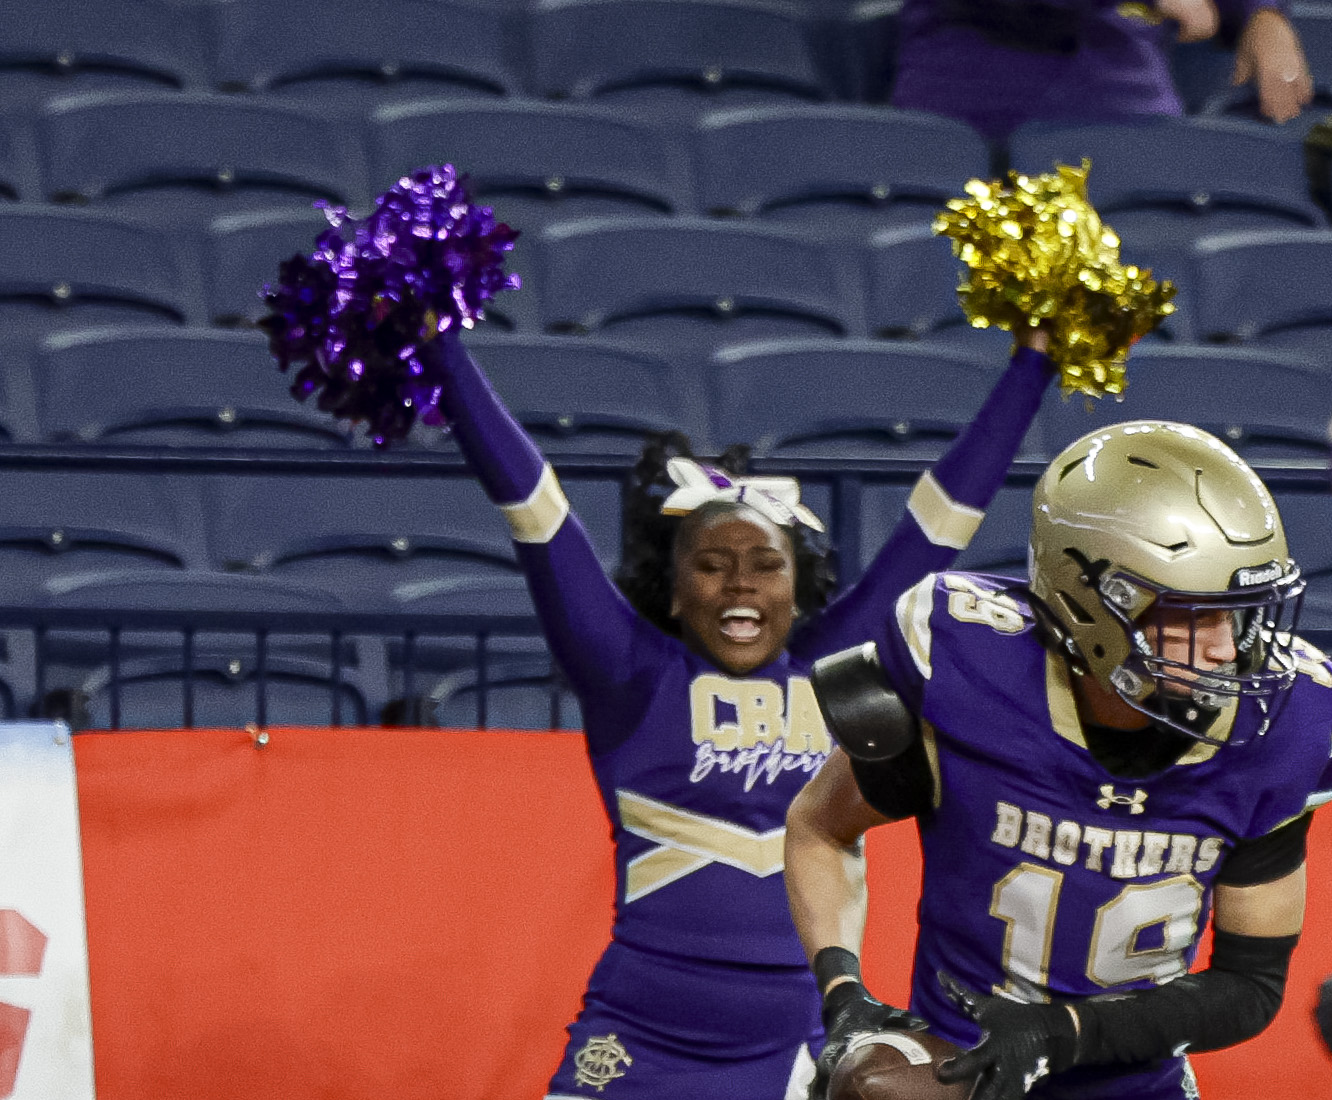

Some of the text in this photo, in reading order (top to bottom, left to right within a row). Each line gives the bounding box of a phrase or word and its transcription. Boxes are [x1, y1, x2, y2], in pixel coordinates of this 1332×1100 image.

[689, 674, 832, 756] CBA
[991, 802, 1225, 879] BROTHERS
[989, 862, 1206, 1005] 19
